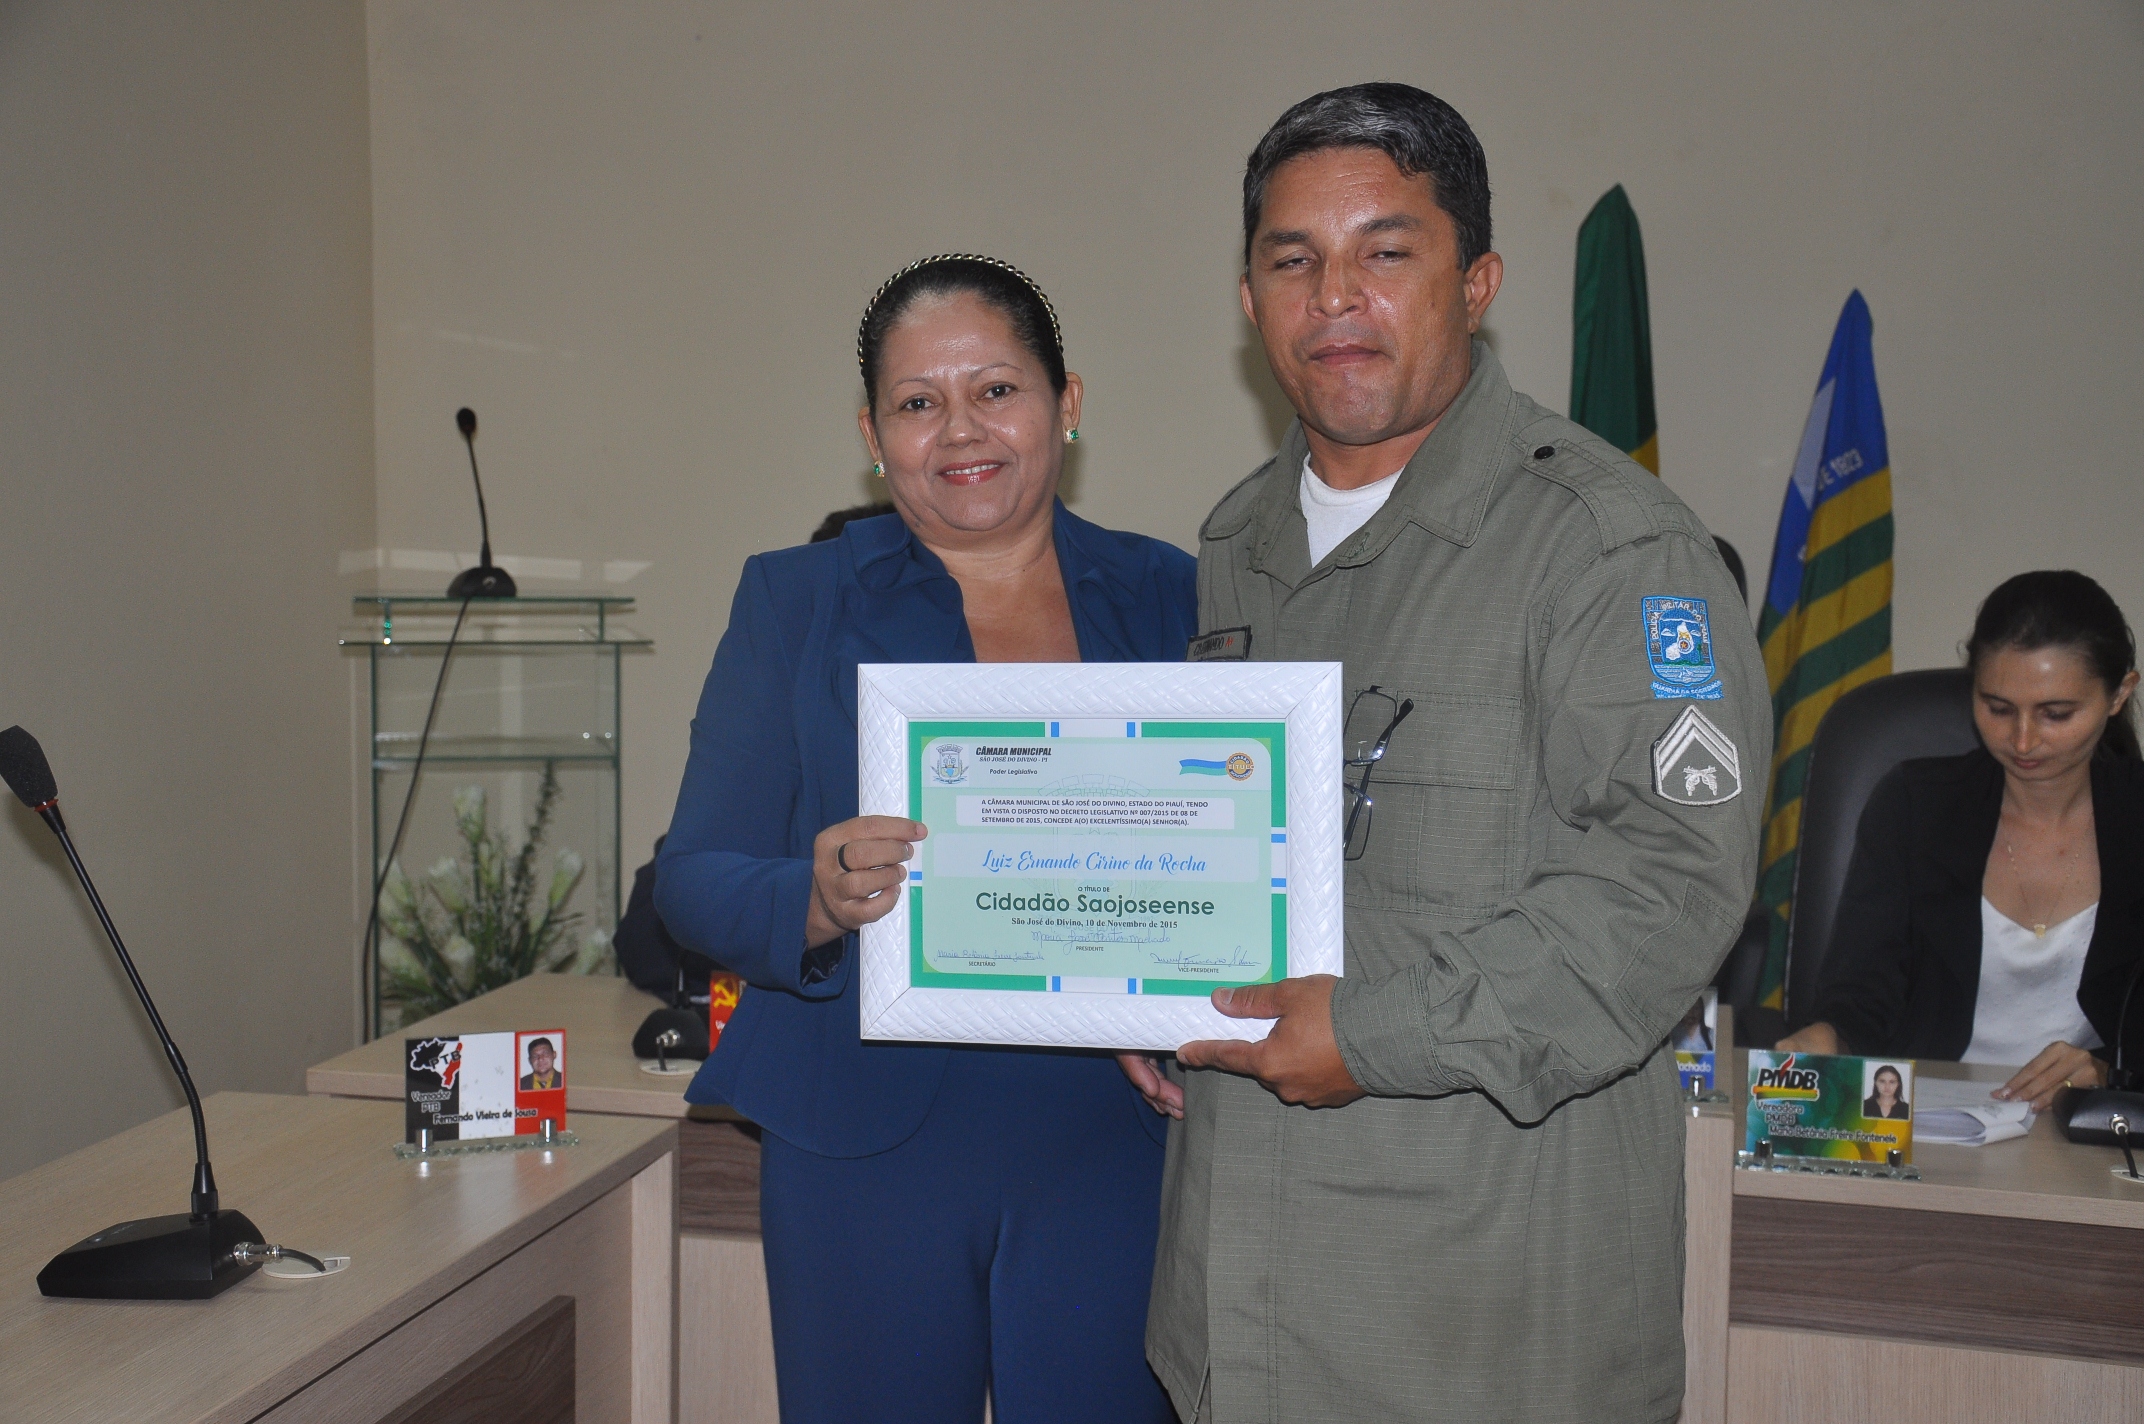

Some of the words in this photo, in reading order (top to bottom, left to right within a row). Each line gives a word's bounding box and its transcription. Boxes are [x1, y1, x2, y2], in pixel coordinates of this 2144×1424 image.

[975, 745, 1008, 756] CÂMARA
[1009, 747, 1052, 756] MUNICIPAL
[1007, 768, 1038, 776] Legislativo
[1165, 800, 1185, 808] PIAUÍ,
[1089, 818, 1151, 826] EXCELENTÍSSIMO(A)
[982, 849, 1014, 873] Luiz
[1017, 850, 1080, 871] Ernando
[1085, 851, 1132, 871] Cirino
[1134, 854, 1153, 871] da
[1158, 852, 1207, 876] Rocha
[975, 891, 1070, 912] Cidadão
[1077, 894, 1215, 918] Saojoseense
[1011, 917, 1025, 925] São
[1026, 917, 1043, 926] José
[1045, 918, 1055, 926] do
[1056, 918, 1084, 928] Divino,
[1086, 919, 1094, 927] 10
[1096, 919, 1106, 927] de
[1107, 920, 1147, 928] Novembro
[1148, 920, 1158, 928] de
[1160, 921, 1178, 929] 2015
[428, 1050, 462, 1070] PTB
[1757, 1067, 1818, 1090] PMDB
[411, 1089, 452, 1102] Vereador
[421, 1101, 441, 1113] PTB
[1756, 1101, 1804, 1115] Vereadora
[432, 1112, 474, 1126] Fernando
[475, 1109, 501, 1120] Vieira
[502, 1108, 513, 1119] de
[1765, 1113, 1797, 1125] PMDB
[1768, 1124, 1794, 1137] Maria
[1829, 1128, 1854, 1141] Freire
[1856, 1130, 1897, 1144] Fontenele
